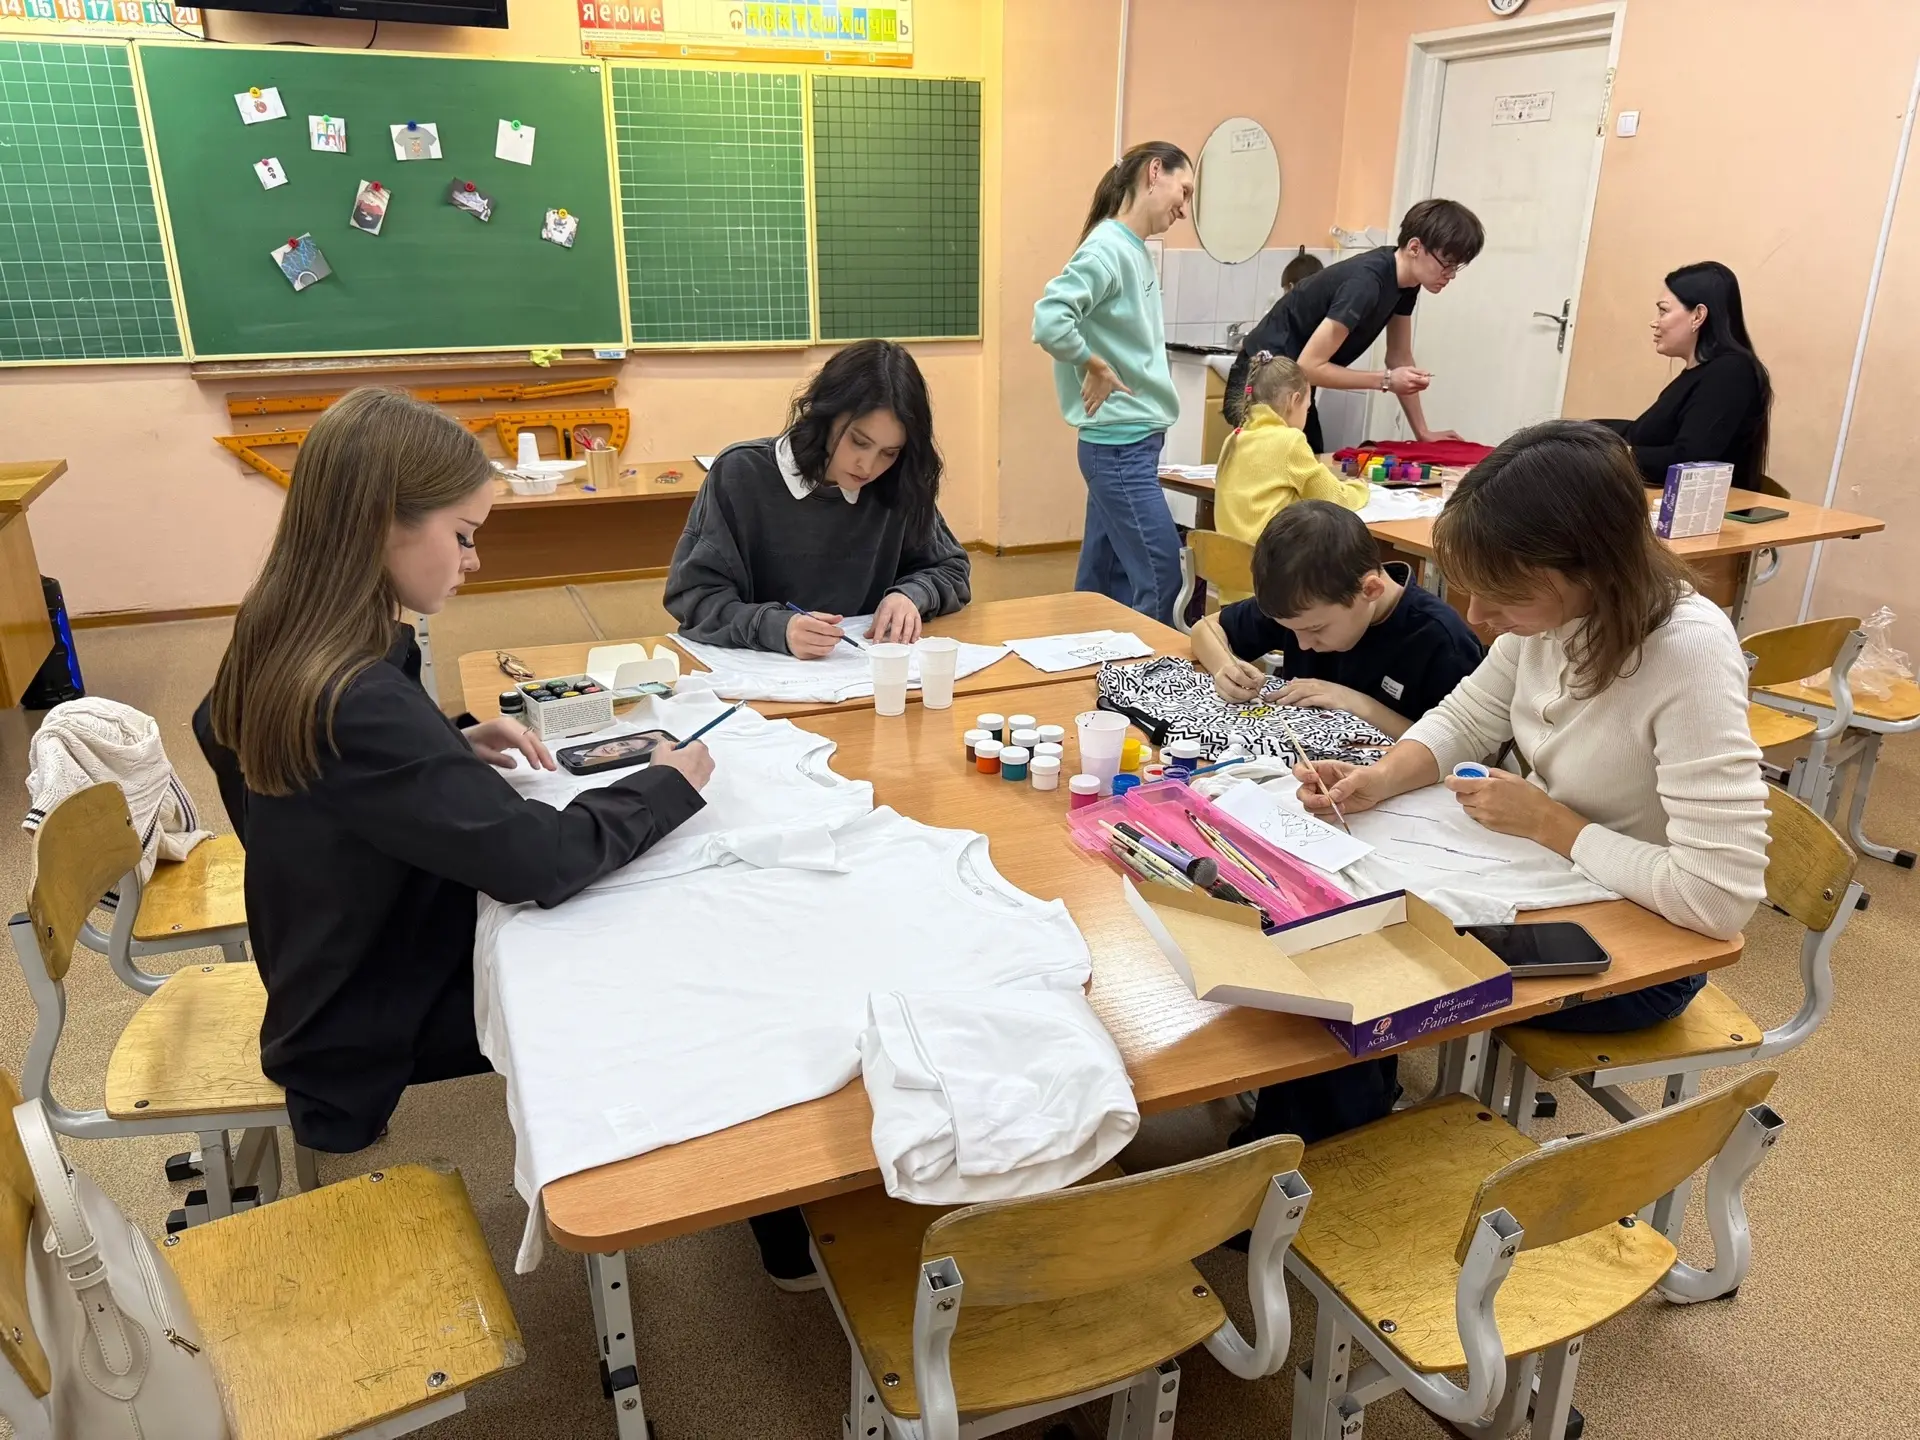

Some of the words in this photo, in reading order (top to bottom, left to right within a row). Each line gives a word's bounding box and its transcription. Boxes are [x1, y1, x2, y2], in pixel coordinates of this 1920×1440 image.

[0, 0, 22, 16] 14
[31, 0, 52, 18] 15
[62, 0, 83, 19] 16
[88, 0, 110, 20] 17
[120, 1, 140, 22] 18
[147, 2, 168, 23] 19
[175, 7, 198, 24] 20
[1431, 995, 1457, 1014] gloss
[1449, 997, 1476, 1012] artistic
[1417, 1011, 1459, 1033] Paints
[1367, 1032, 1397, 1048] ACRYL
